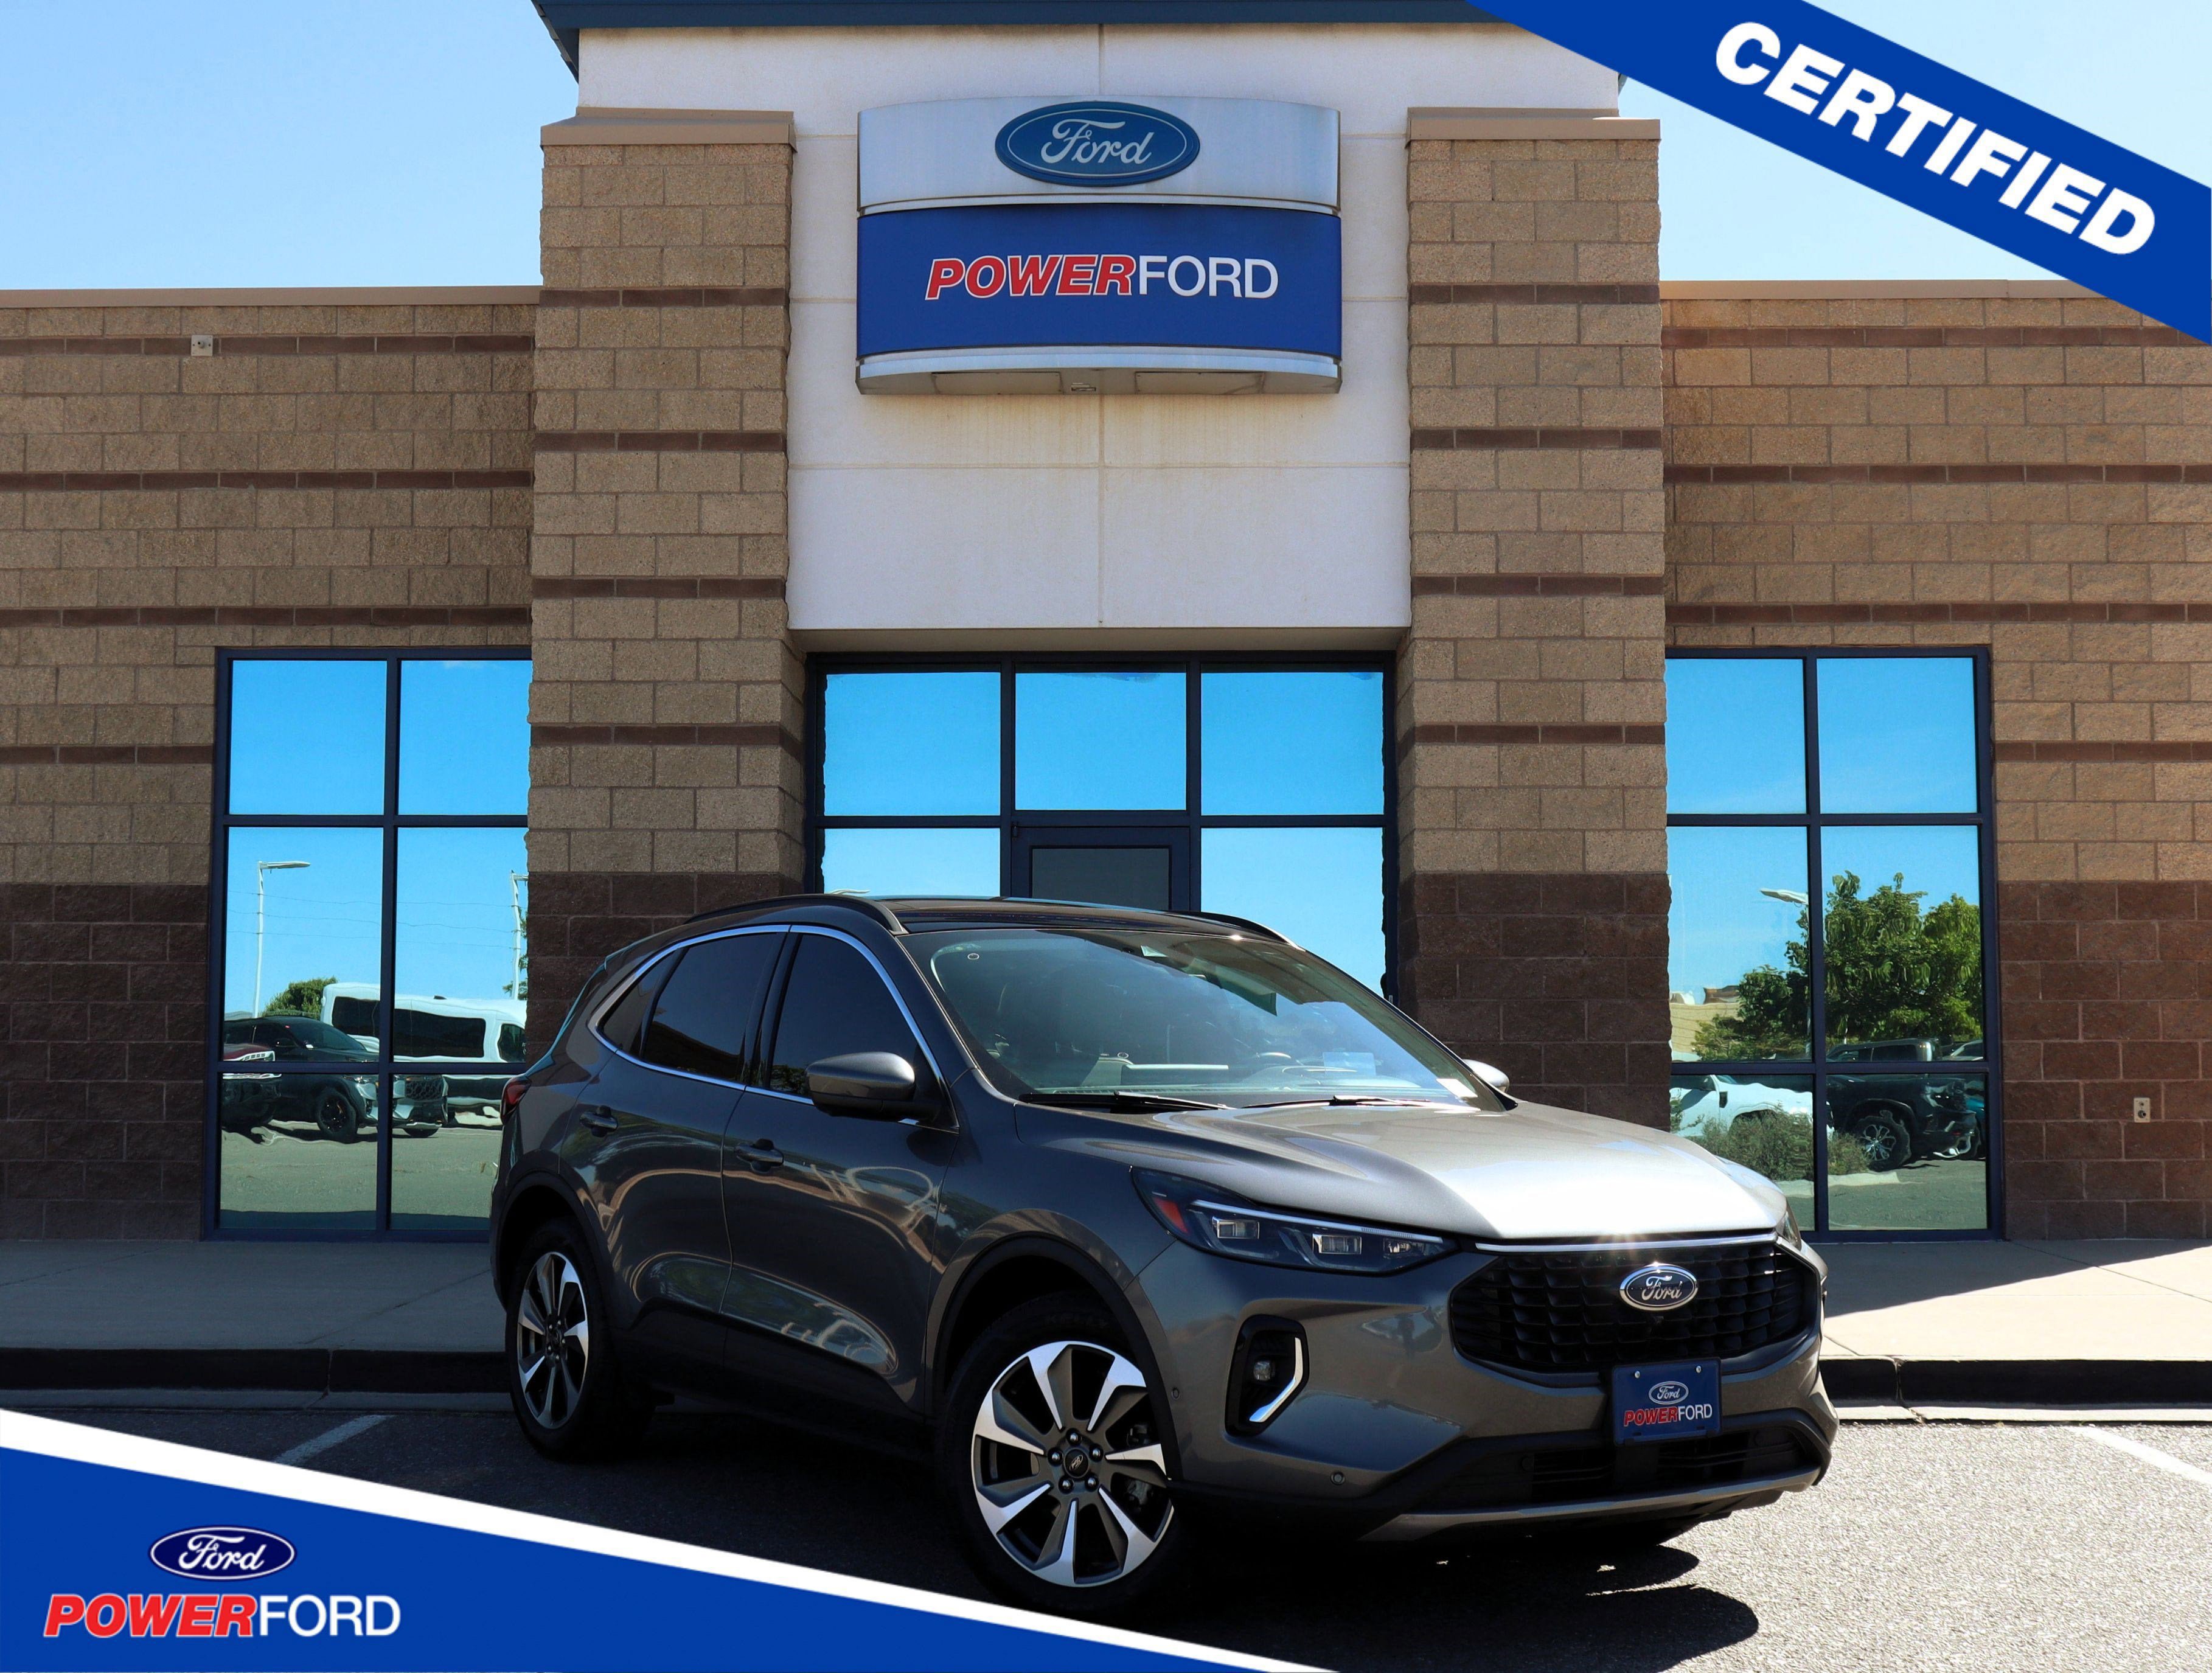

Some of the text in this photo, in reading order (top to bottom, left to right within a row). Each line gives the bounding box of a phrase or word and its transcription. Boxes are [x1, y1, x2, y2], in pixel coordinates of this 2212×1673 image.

[1041, 119, 1153, 164] Ford
[925, 254, 1279, 300] POWERFORD
[1641, 1276, 1683, 1301] Ford
[1657, 1386, 1680, 1399] Ford
[1624, 1403, 1713, 1427] POWERFORD
